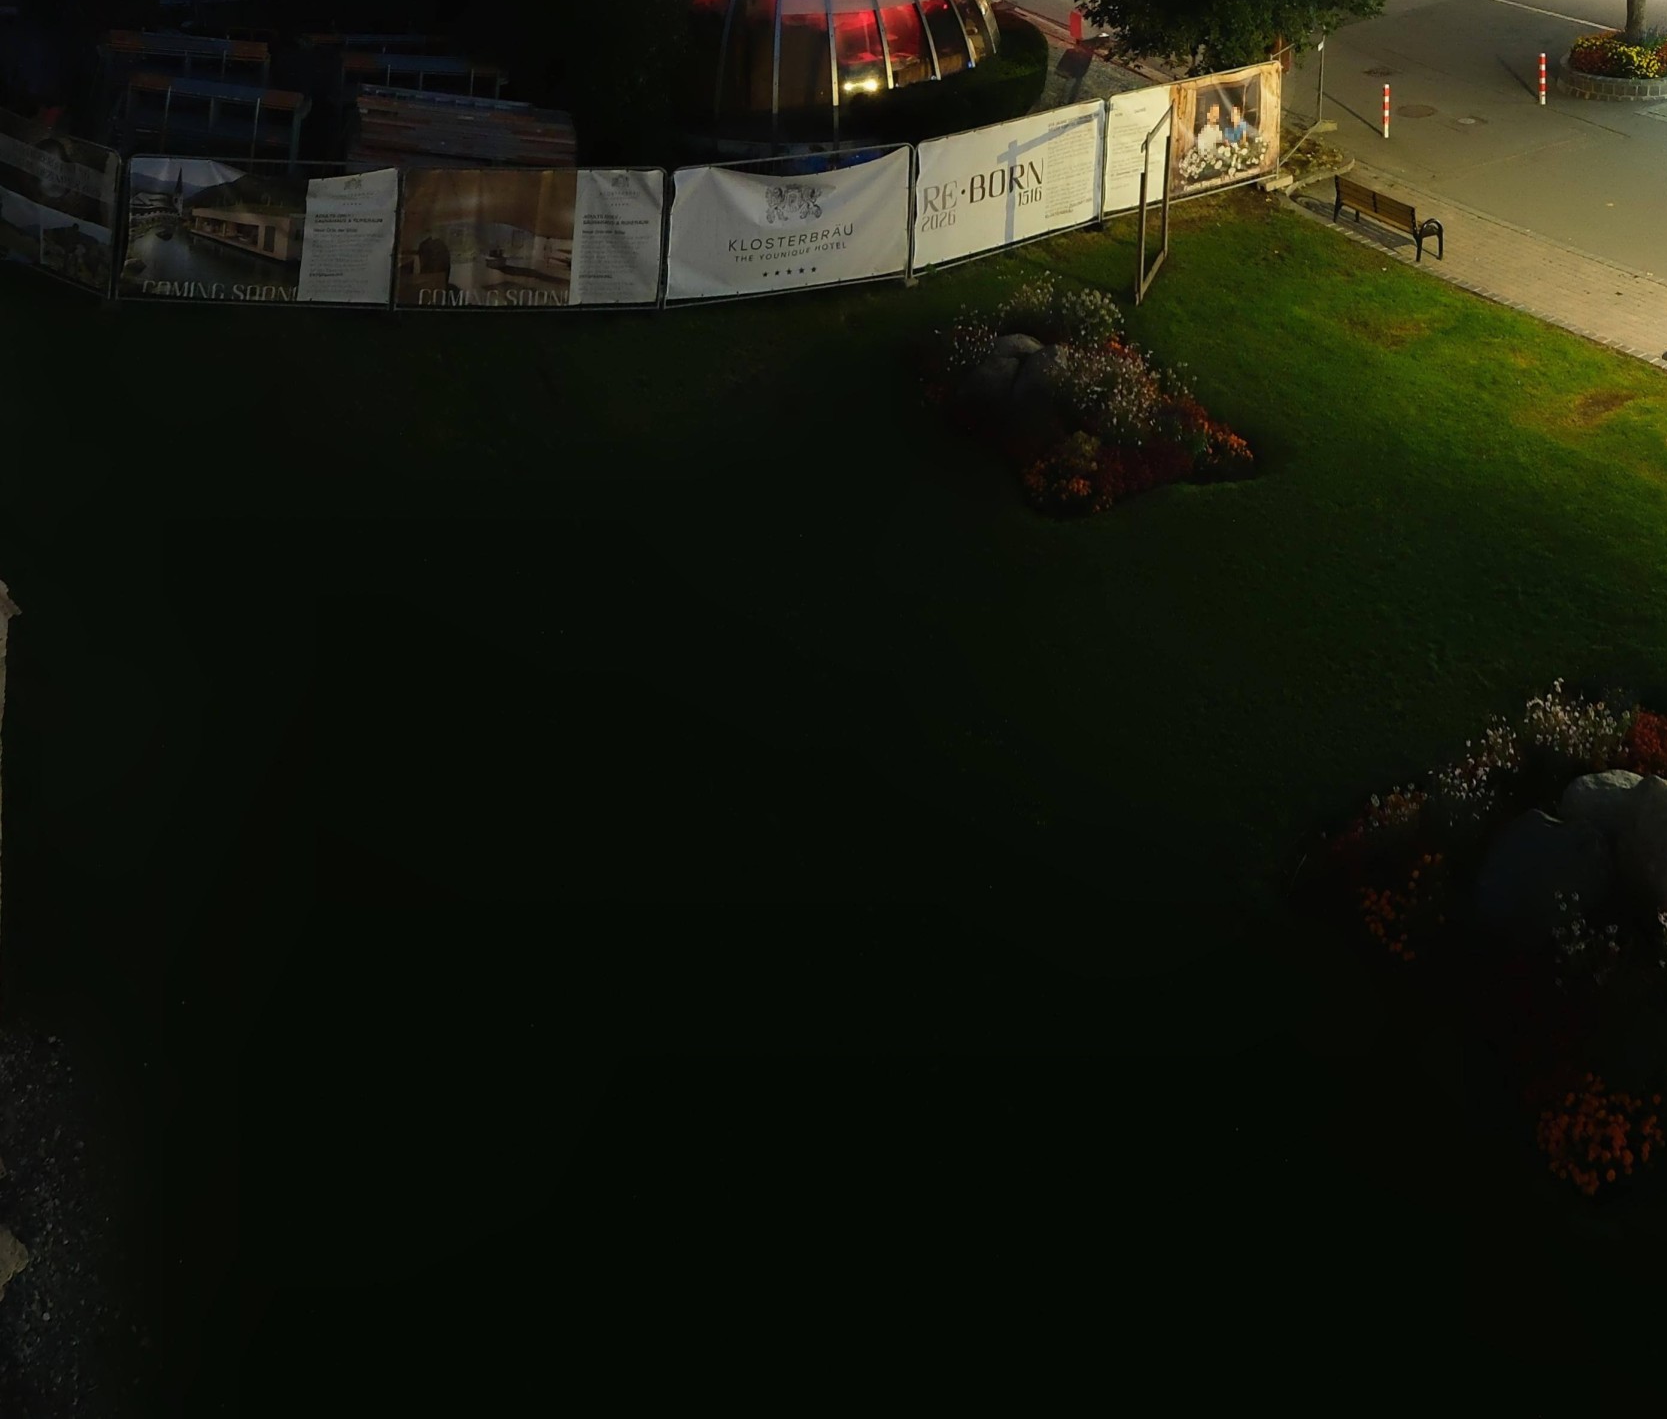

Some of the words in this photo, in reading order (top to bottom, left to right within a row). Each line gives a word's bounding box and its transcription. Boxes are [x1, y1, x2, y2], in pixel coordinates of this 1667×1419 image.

[1018, 186, 1043, 207] 1516
[922, 209, 957, 232] 2026
[728, 222, 854, 252] KLOSTERBRÄU
[735, 255, 754, 263] THE
[759, 247, 810, 261] YOUNIQUE
[815, 241, 847, 252] HOTEL
[142, 280, 225, 300] COMING
[418, 288, 499, 307] COMING
